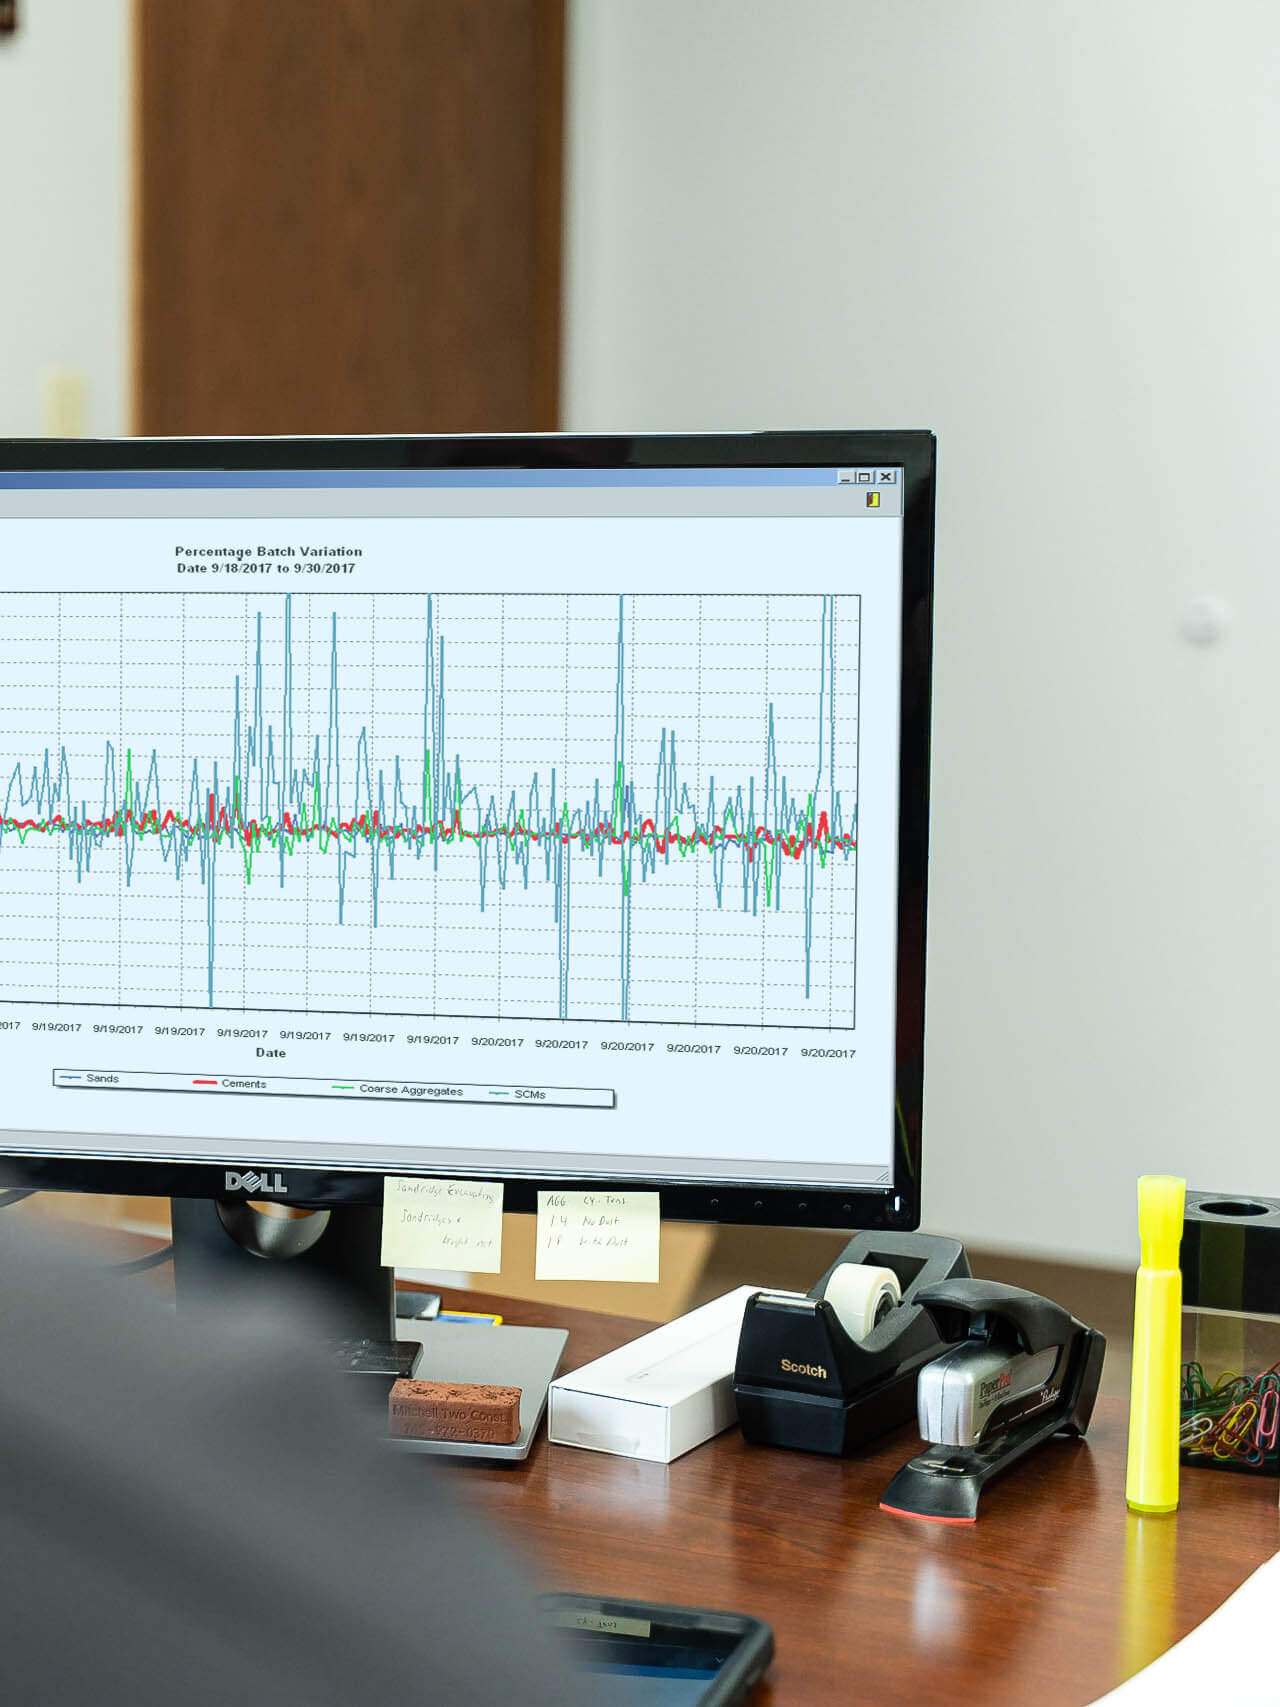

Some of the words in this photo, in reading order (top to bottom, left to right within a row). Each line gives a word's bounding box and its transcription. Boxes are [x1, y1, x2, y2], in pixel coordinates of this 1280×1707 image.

[175, 545, 252, 562] Percentage
[257, 546, 296, 557] Batch
[299, 546, 363, 557] Variation
[177, 562, 208, 574] Date
[211, 562, 273, 574] 9/18/2017
[277, 564, 290, 574] to
[293, 562, 356, 574] 9/30/2017
[31, 1022, 82, 1032] 9/19/2017
[92, 1024, 144, 1034] 9/19/2017
[154, 1026, 206, 1037] 9/19/2017
[216, 1028, 269, 1039] 9/19/2017
[279, 1030, 332, 1041] 9/19/2017
[342, 1032, 396, 1043] 9/19/2017
[406, 1034, 460, 1045] 9/19/2017
[471, 1036, 525, 1047] 9/20/2017
[535, 1039, 589, 1049] 9/20/2017
[600, 1041, 655, 1052] 9/20/2017
[666, 1043, 721, 1054] 9/20/2017
[733, 1045, 789, 1056] 9/20/2017
[255, 1047, 287, 1058] Date
[800, 1048, 857, 1059] 9/20/2017
[86, 1073, 120, 1084] Sands
[221, 1078, 267, 1089] Cements
[359, 1083, 399, 1094] Coarse
[400, 1085, 464, 1097] Aggregates
[514, 1089, 546, 1100] SCMs
[225, 1171, 287, 1192] DELL
[781, 1359, 827, 1379] Scotch
